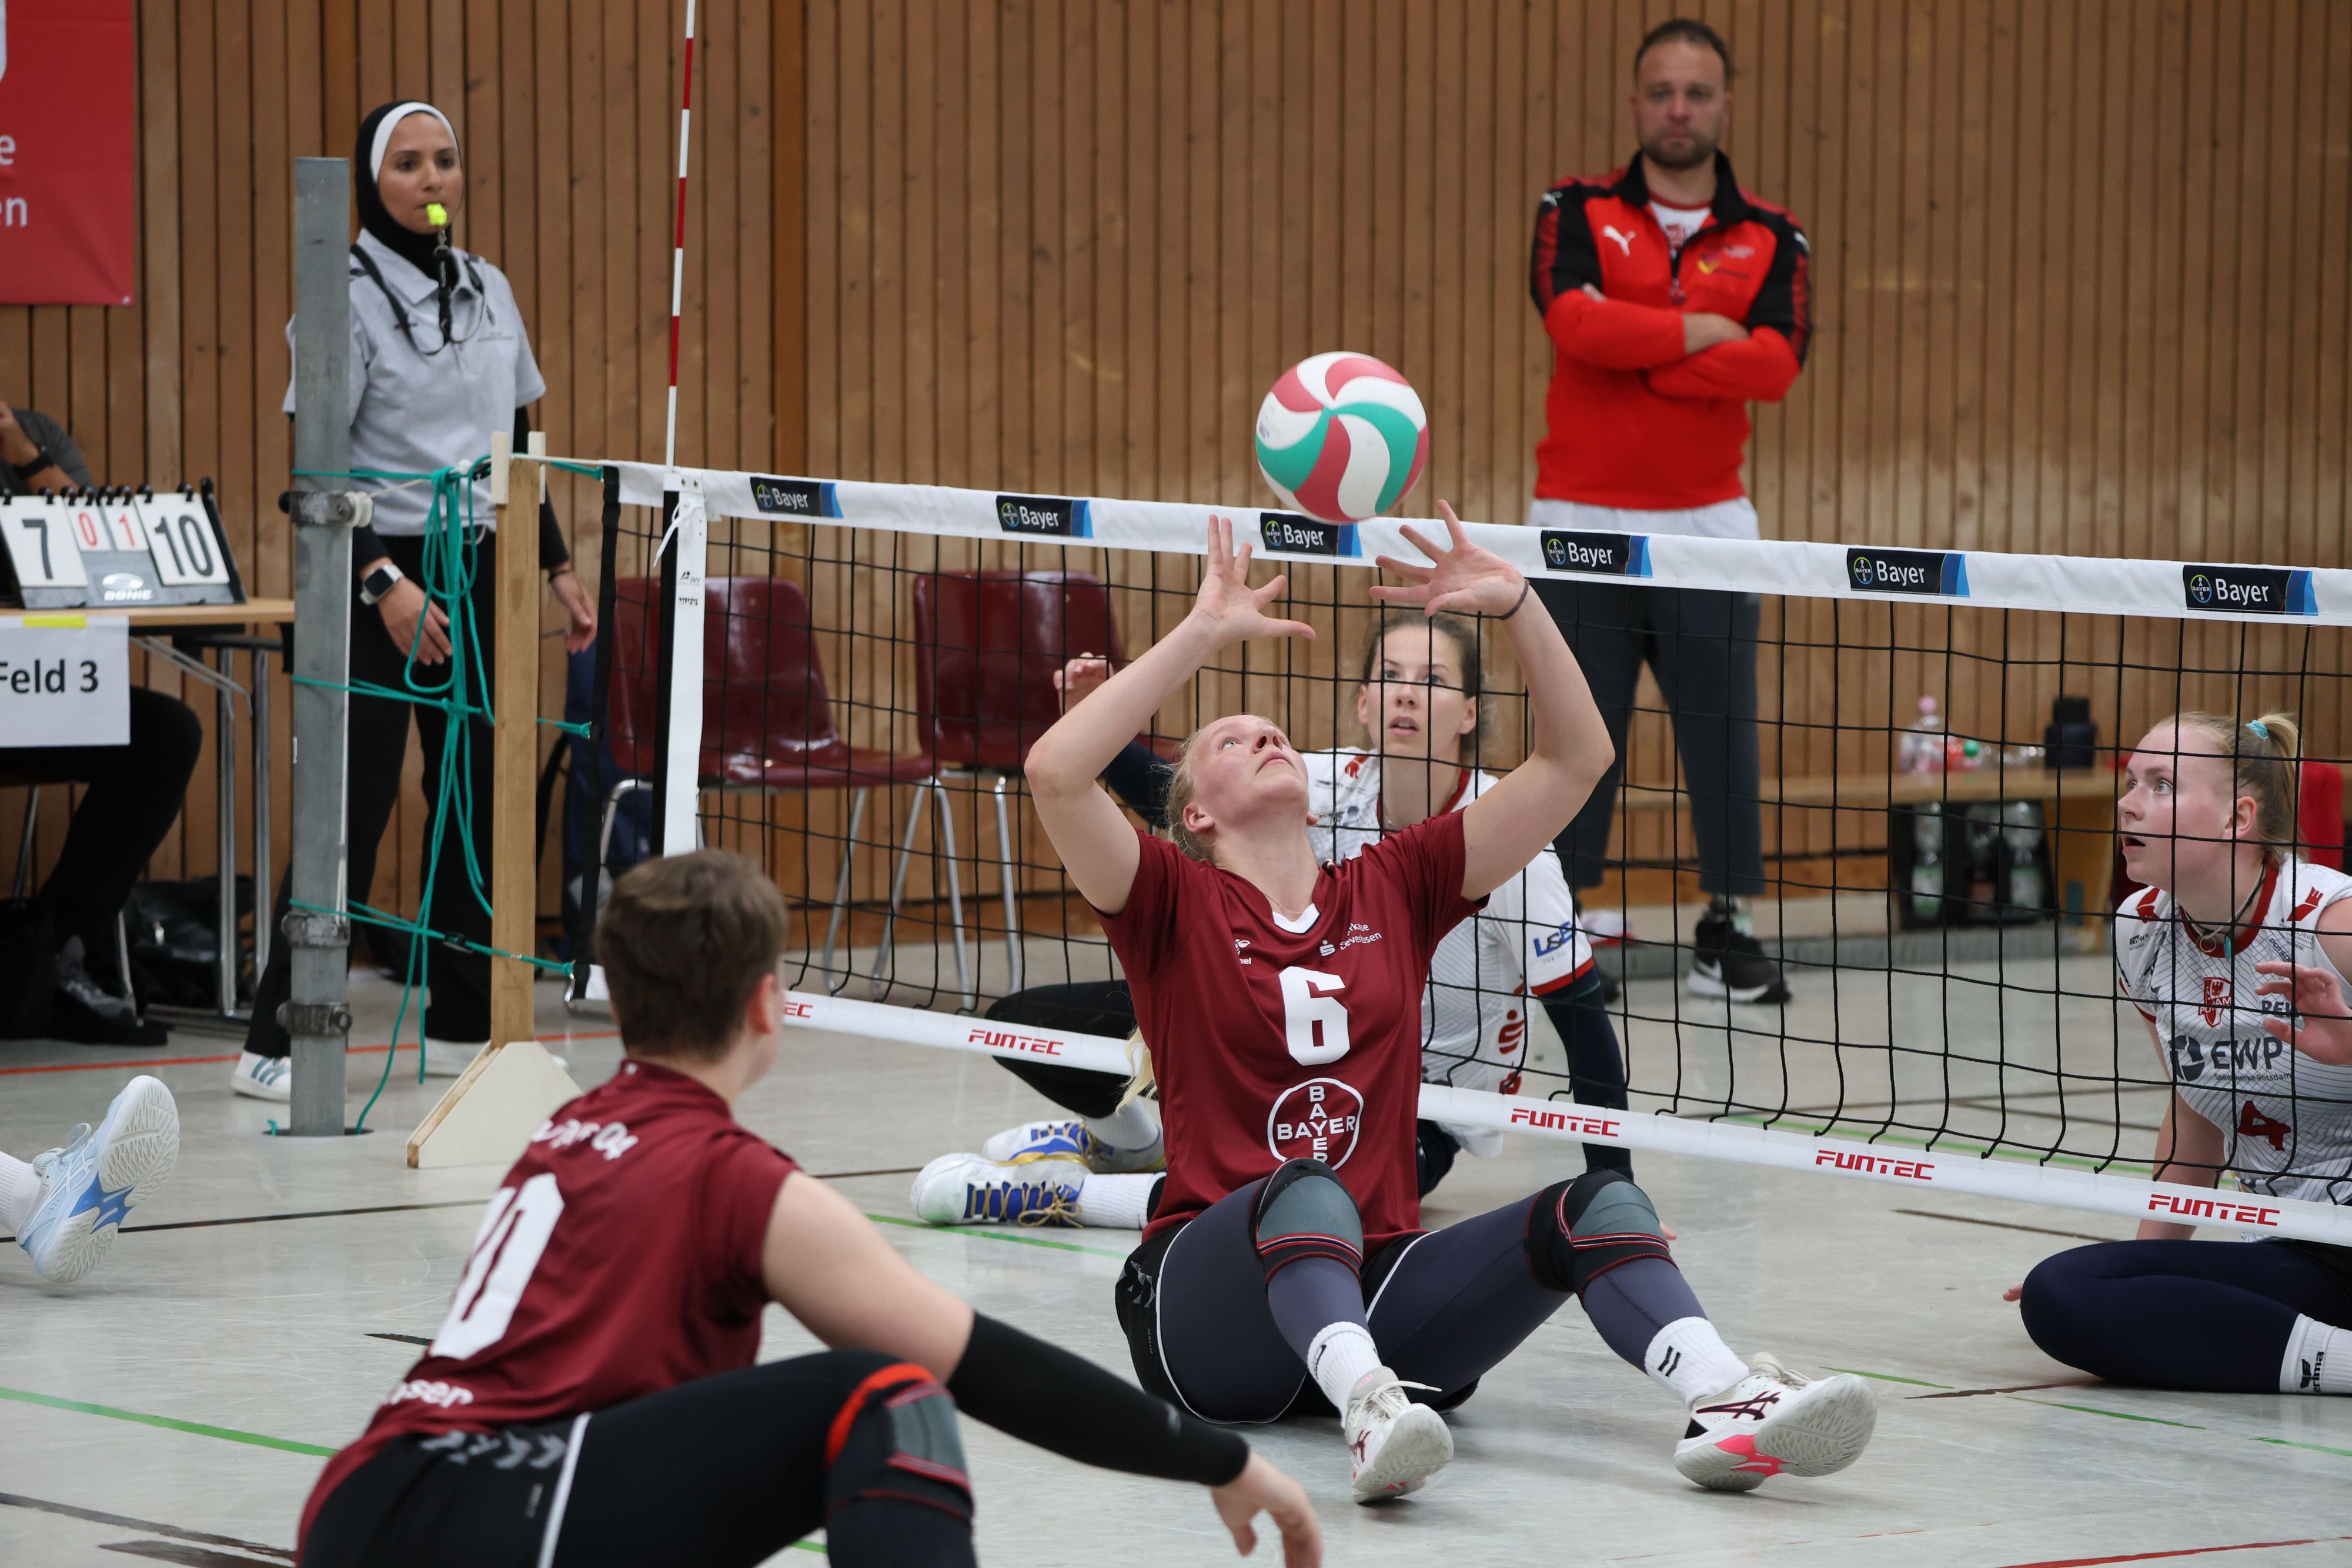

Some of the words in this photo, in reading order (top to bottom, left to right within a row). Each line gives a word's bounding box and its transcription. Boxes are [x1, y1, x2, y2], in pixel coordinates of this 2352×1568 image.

[771, 487, 808, 510] Bayer
[1019, 505, 1059, 530] Bayer
[22, 518, 54, 580] 7
[78, 511, 98, 547] 0
[118, 513, 135, 547] 1
[155, 514, 213, 577] 10
[1283, 523, 1324, 549] Bayer
[1568, 541, 1612, 568] Bayer
[1876, 560, 1925, 587] Bayer
[2215, 578, 2269, 606] Bayer
[80, 660, 99, 693] 3
[1278, 966, 1350, 1066] 6
[968, 1029, 1064, 1055] FUNTEC
[2211, 1037, 2283, 1070] EWP
[1277, 1115, 1356, 1141] BAYER
[1511, 1108, 1620, 1137] FUNTEC
[2237, 1101, 2291, 1151] 4
[1816, 1150, 1935, 1180] FUNTEC
[2149, 1194, 2280, 1226] FUNTEC
